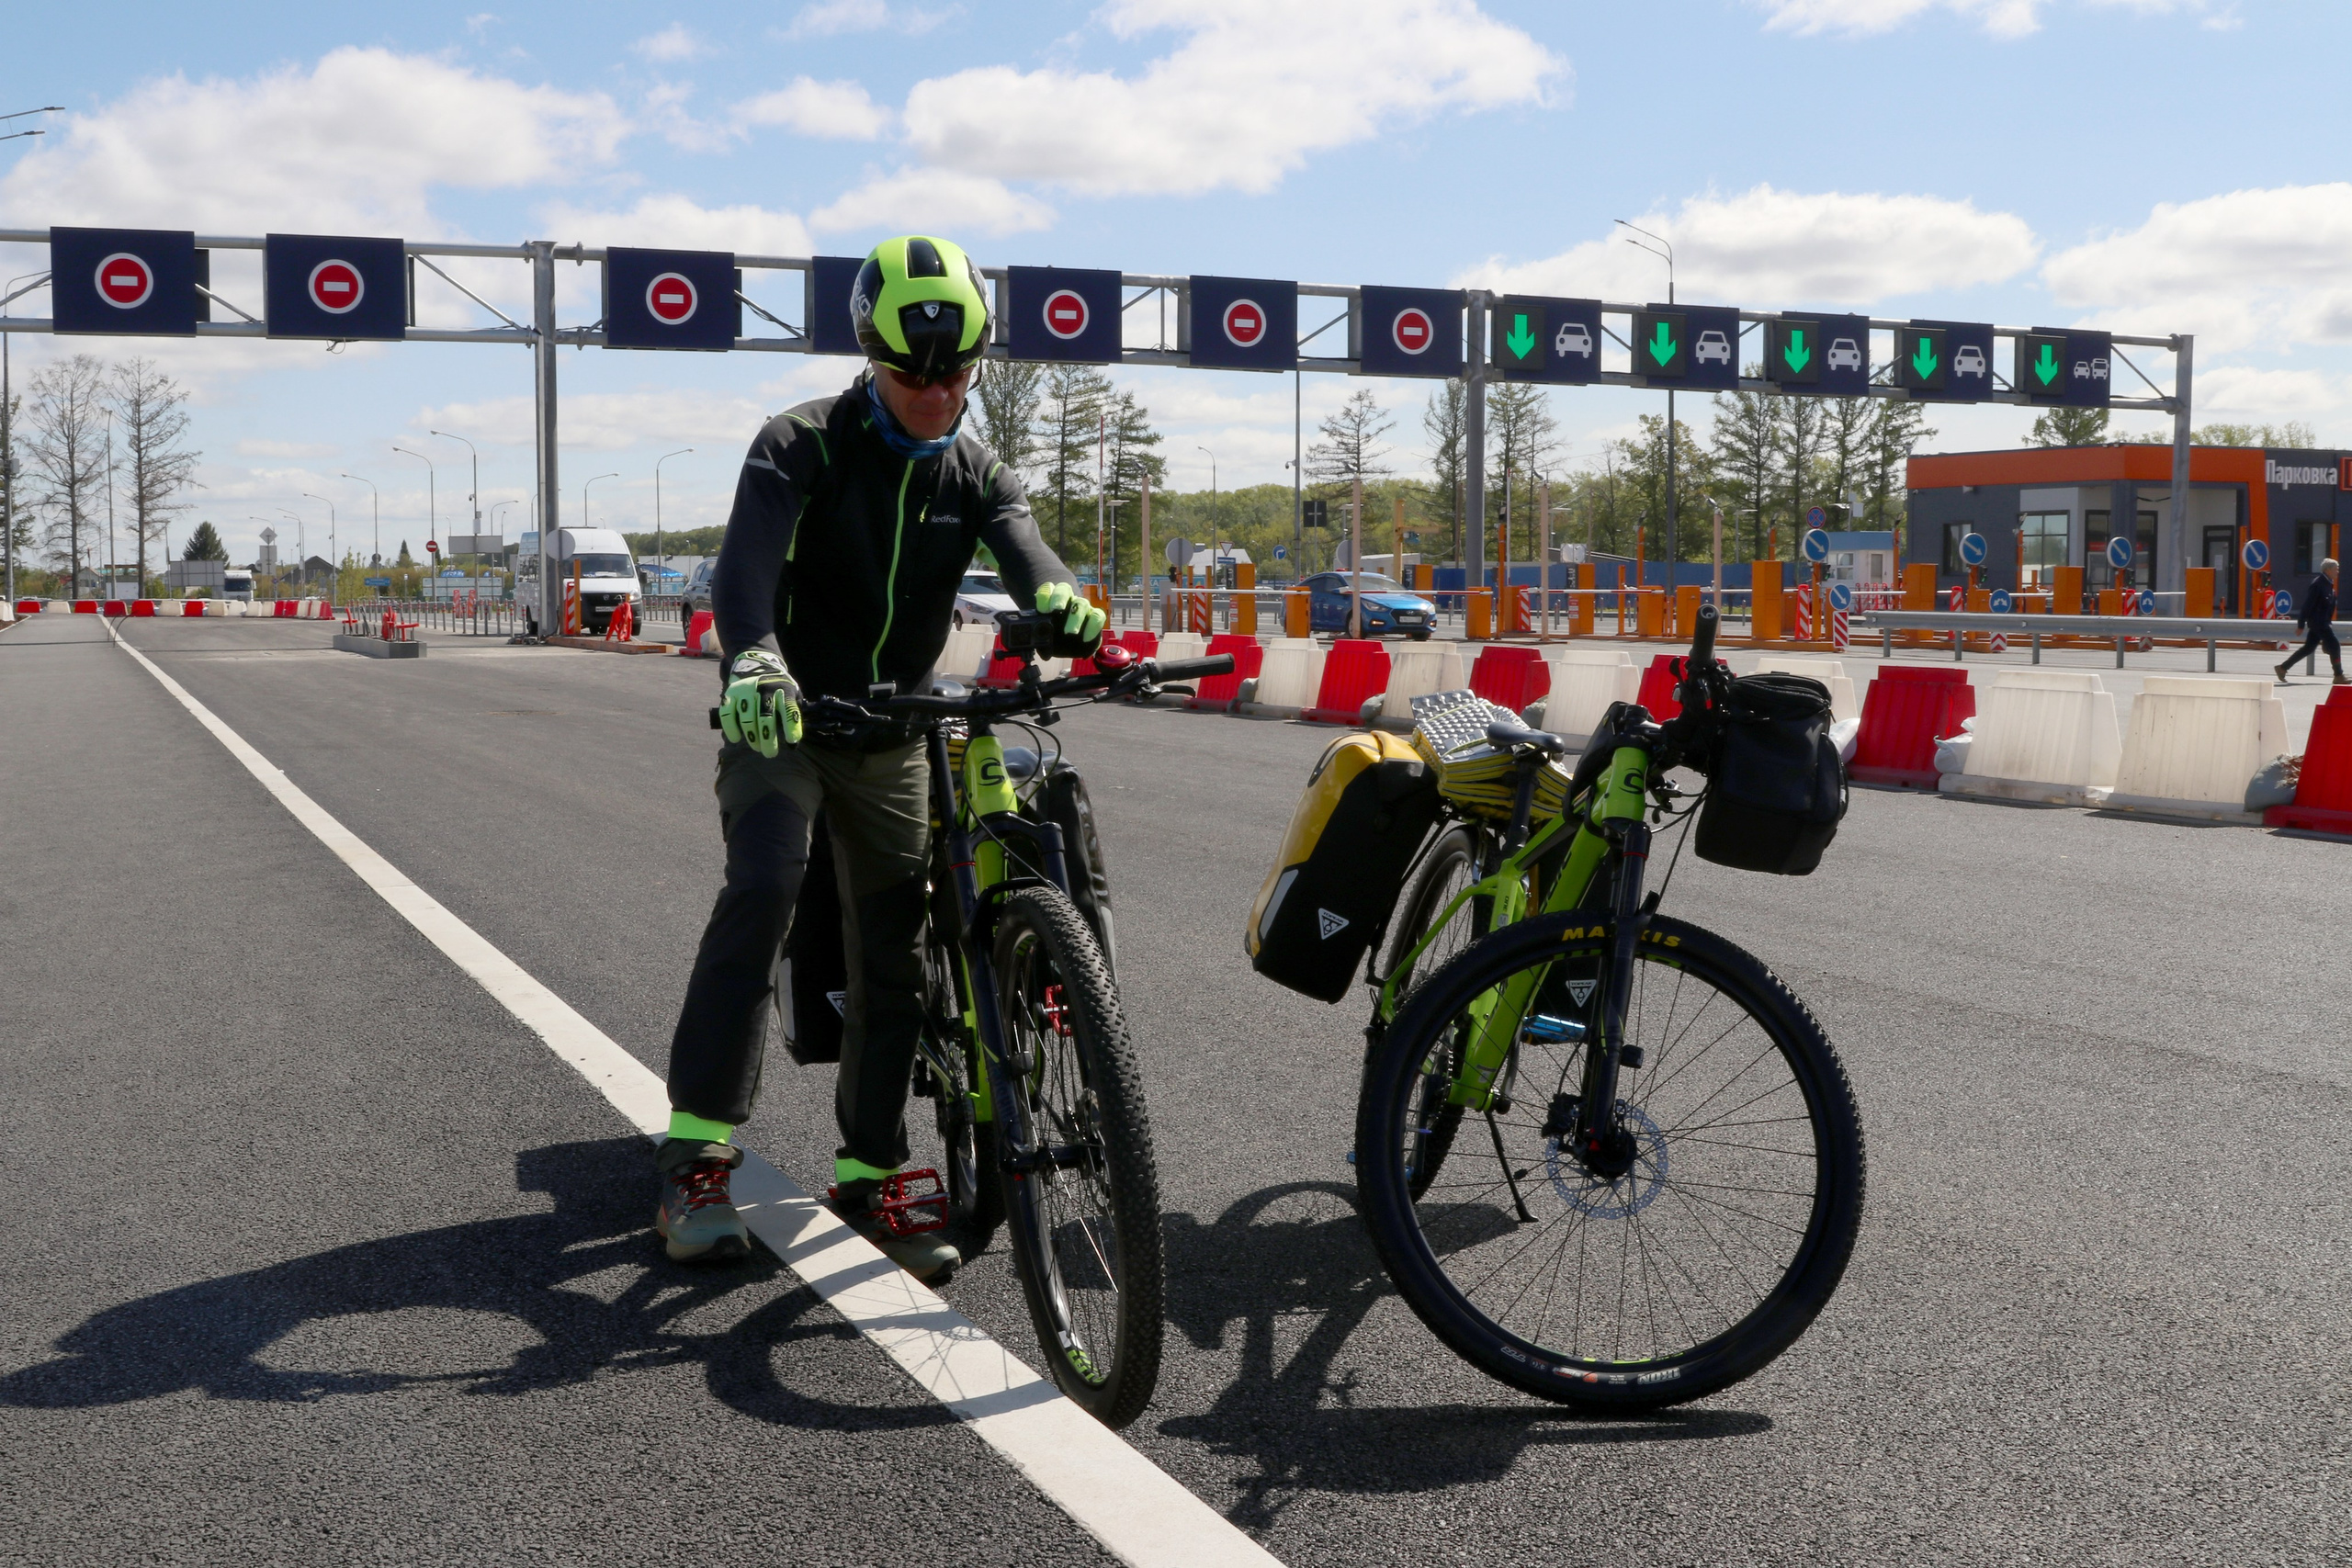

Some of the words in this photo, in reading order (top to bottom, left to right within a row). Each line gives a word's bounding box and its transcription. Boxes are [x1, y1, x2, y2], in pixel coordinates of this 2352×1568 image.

[2266, 459, 2337, 490] Парковка
[1562, 925, 1681, 948] MAIS
[1637, 1367, 1681, 1385] IKON
